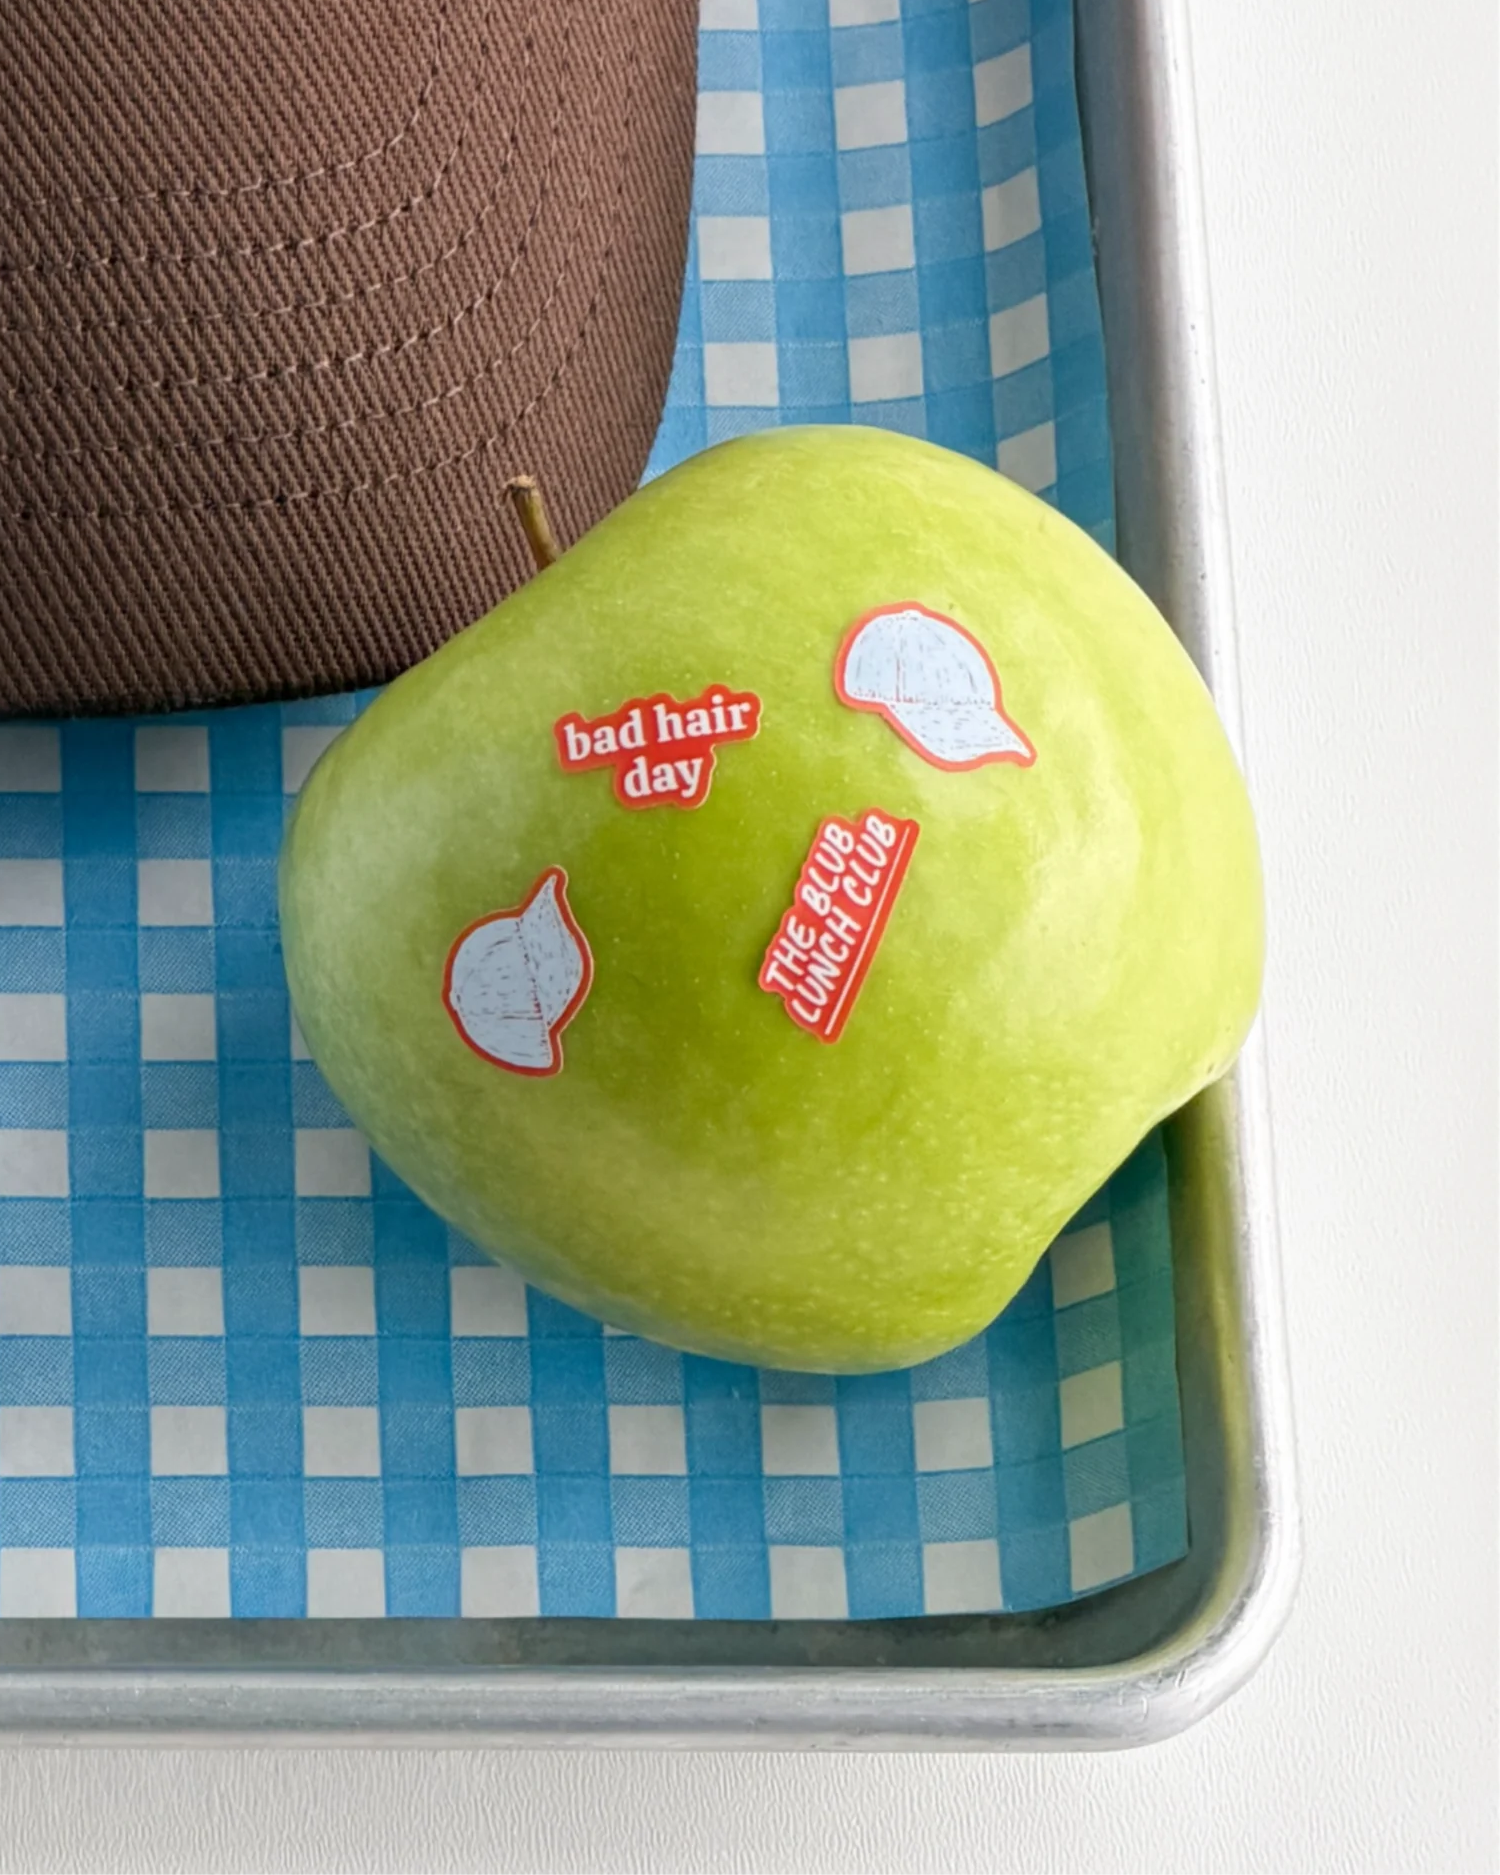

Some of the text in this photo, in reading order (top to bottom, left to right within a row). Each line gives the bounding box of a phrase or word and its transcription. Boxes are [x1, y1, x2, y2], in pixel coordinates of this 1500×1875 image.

[563, 693, 752, 762] bad hair
[623, 755, 705, 799] day
[765, 822, 854, 992] THE BLUB
[791, 814, 897, 1023] LUNCH CLUB
